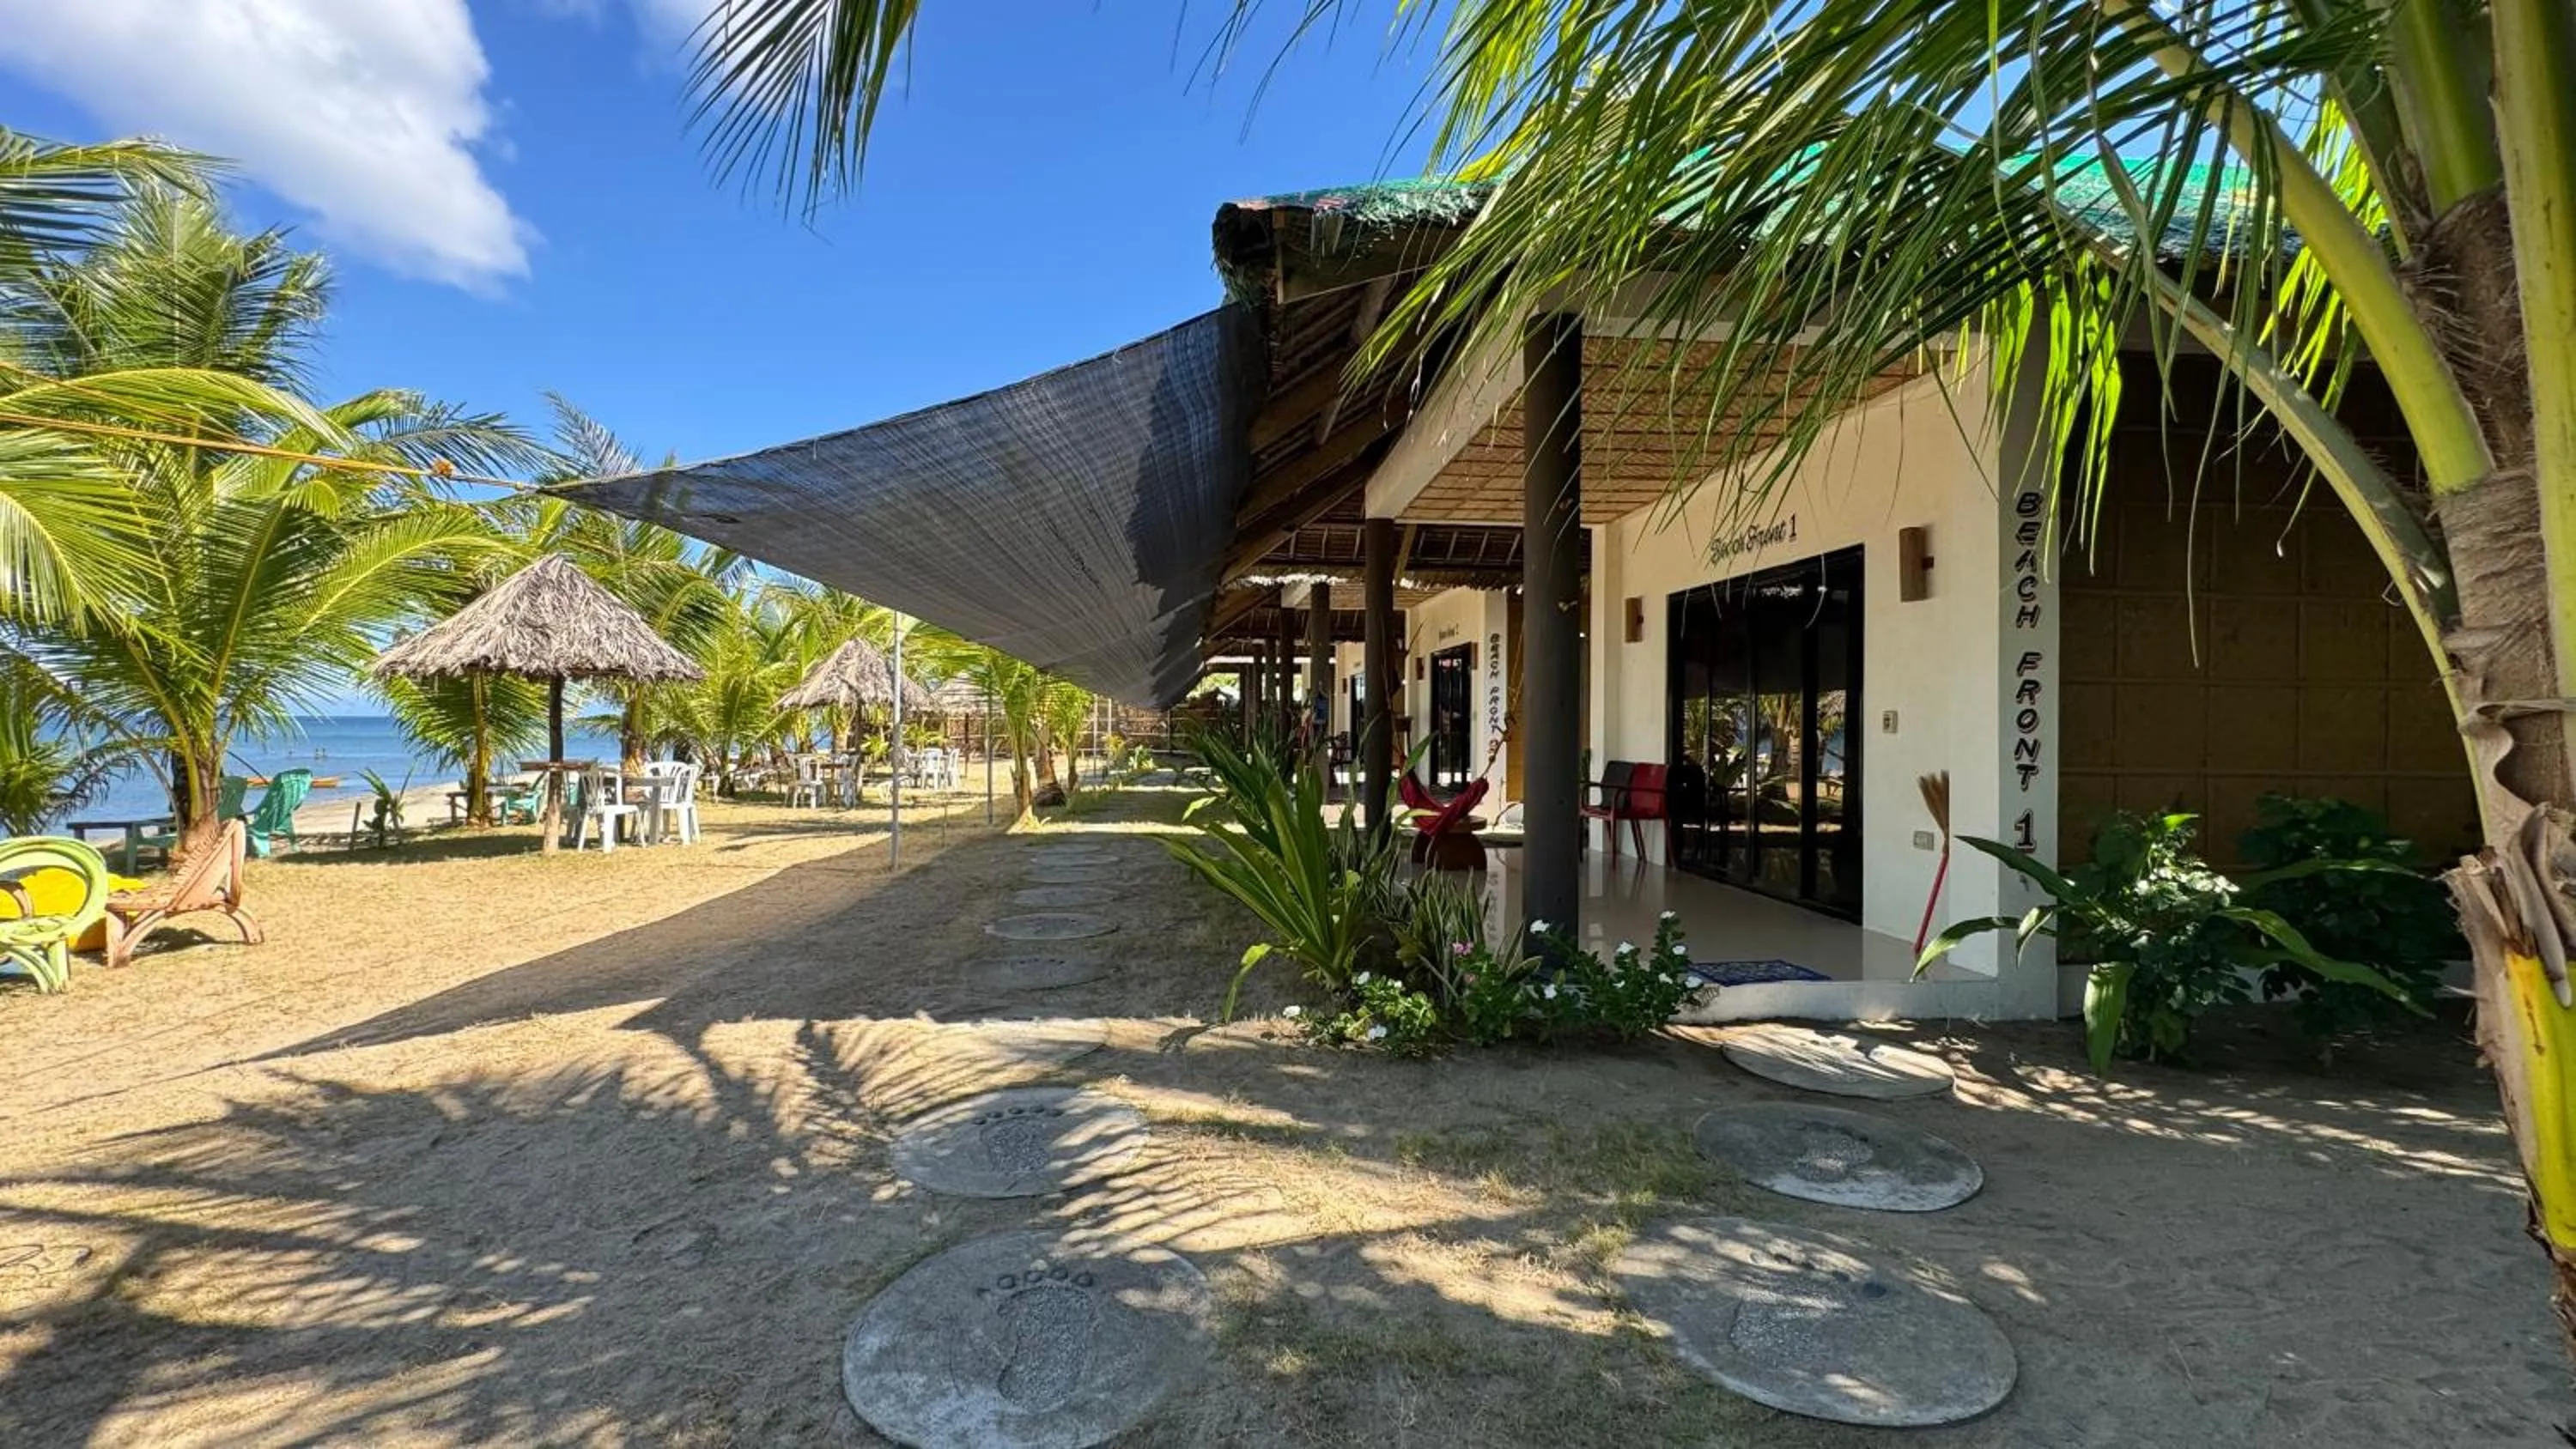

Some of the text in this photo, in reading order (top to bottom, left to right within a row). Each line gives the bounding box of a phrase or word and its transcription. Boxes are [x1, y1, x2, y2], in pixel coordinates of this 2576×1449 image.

[1789, 512, 1797, 543] 1
[1489, 634, 1501, 679] BEACH
[2014, 492, 2043, 853] BEACH FRONT 1
[1488, 687, 1500, 733] FRONT
